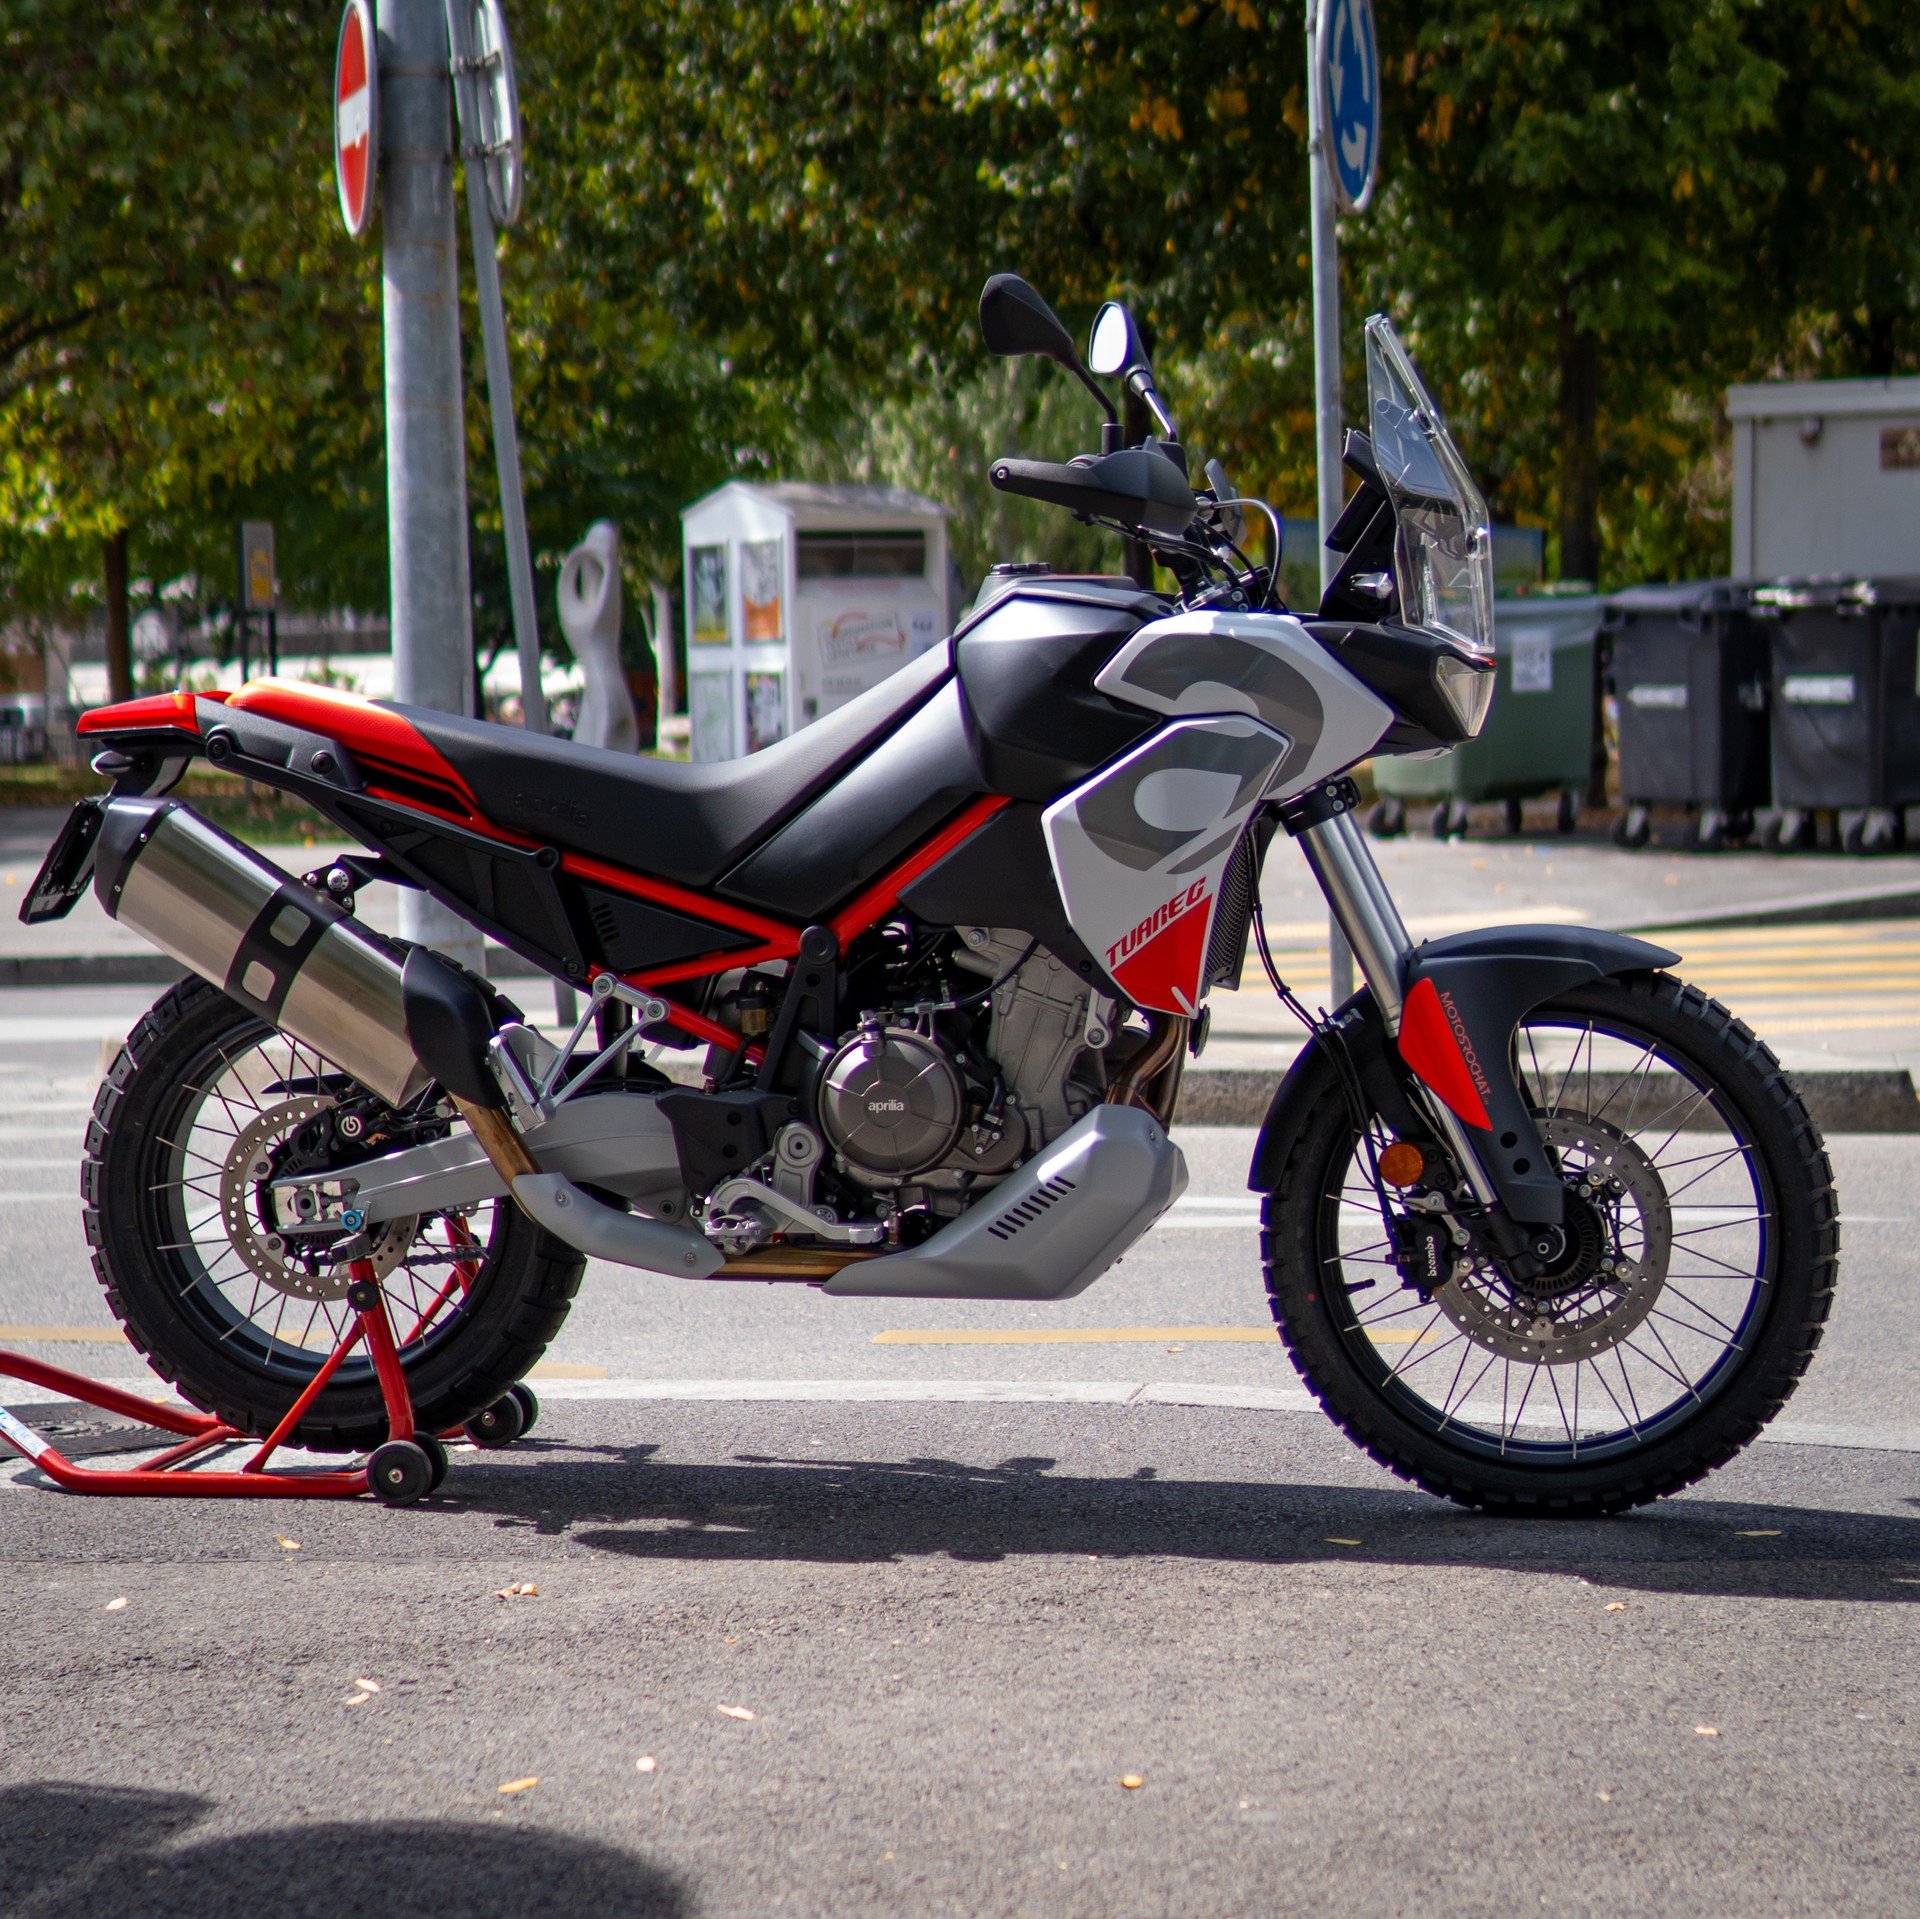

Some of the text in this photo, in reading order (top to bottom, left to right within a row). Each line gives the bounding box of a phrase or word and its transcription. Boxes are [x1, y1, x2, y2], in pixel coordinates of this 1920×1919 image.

[1105, 876, 1207, 968] TUAREG
[868, 1099, 904, 1114] aprilia
[1425, 1235, 1437, 1277] brembo
